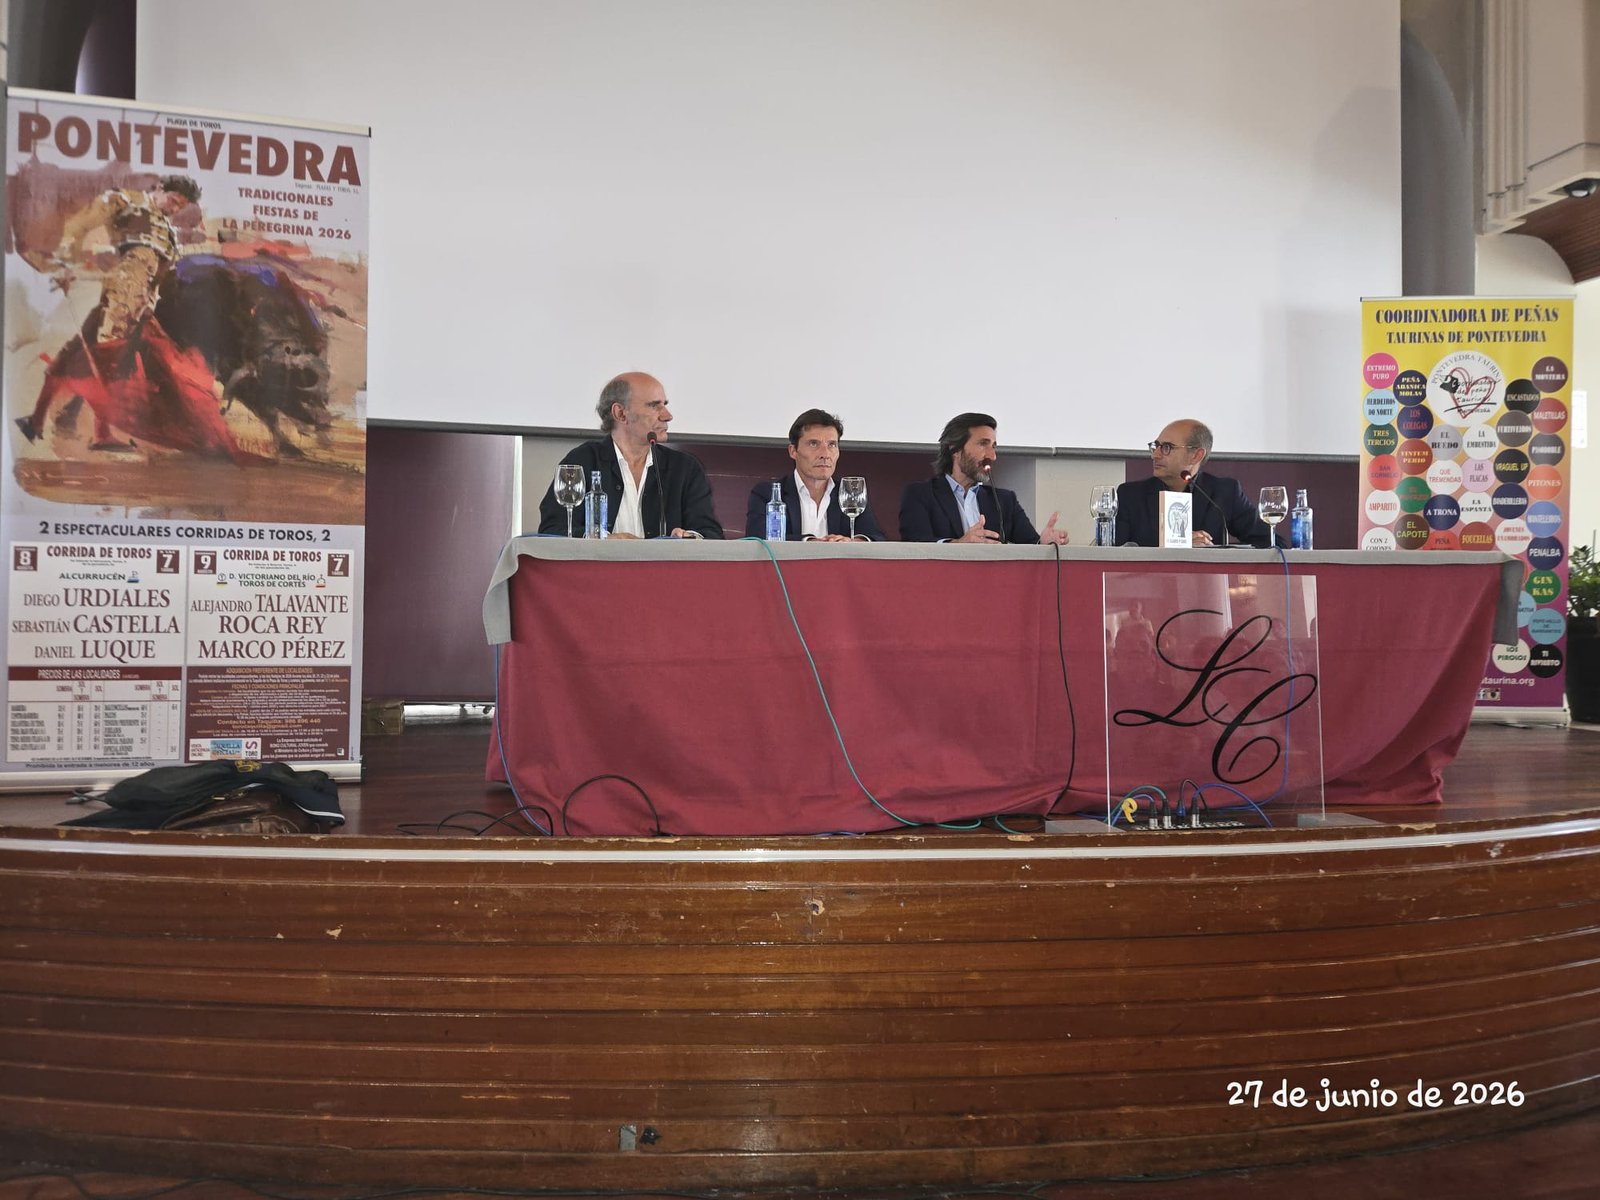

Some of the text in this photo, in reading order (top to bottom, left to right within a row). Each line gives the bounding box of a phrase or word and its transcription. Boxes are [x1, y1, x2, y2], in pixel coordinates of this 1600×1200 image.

[166, 117, 222, 130] PLAZA DE TOROS
[18, 111, 361, 186] PONTEVEDRA
[238, 187, 334, 207] TRADICIONALES
[253, 205, 319, 221] FIESTAS DE
[222, 218, 352, 240] LA PEREGRINA 2026
[1376, 304, 1559, 324] COORDINADORA DE PEÑAS
[1386, 329, 1546, 344] TAURINAS DE PONTEVEDRA
[1401, 376, 1421, 384] PEÑA
[1366, 398, 1396, 406] HERDEIROS
[1534, 411, 1566, 420] MALETILLAS
[1402, 422, 1428, 430] COLEGAS
[1367, 438, 1396, 447] TERCIOS
[1469, 474, 1489, 483] FLACAS
[1528, 479, 1561, 487] PITONES
[1368, 502, 1398, 511] AMPARITO
[1434, 508, 1458, 516] TRONA
[39, 521, 331, 542] 2 ESPECTACULARES CORRIDAS DE TOROS, 2
[1406, 521, 1416, 529] EL
[1396, 530, 1428, 538] CAPOTE
[1461, 535, 1493, 543] FOUCELLAS
[19, 551, 32, 566] 8
[46, 545, 152, 559] CORRIDA DE TOROS
[223, 549, 322, 562] CORRIDA DE TOROS
[162, 554, 174, 569] 7
[200, 555, 212, 570] 9
[333, 557, 344, 572] 7
[59, 570, 126, 581] ALCURRUCÉN
[238, 573, 286, 581] VICTORIANO
[302, 572, 316, 581] RÍO
[1532, 575, 1553, 584] GIN
[23, 587, 171, 609] DIEGO URDIALES
[1532, 588, 1554, 596] KAS
[190, 594, 349, 615] ALEJANDRO TALAVANTE
[11, 614, 181, 635] SEBASTIÁN CASTELLA
[218, 616, 327, 635] ROCA REY
[34, 639, 156, 664] DANIEL LUQUE
[198, 636, 346, 660] MARCO PÉREZ
